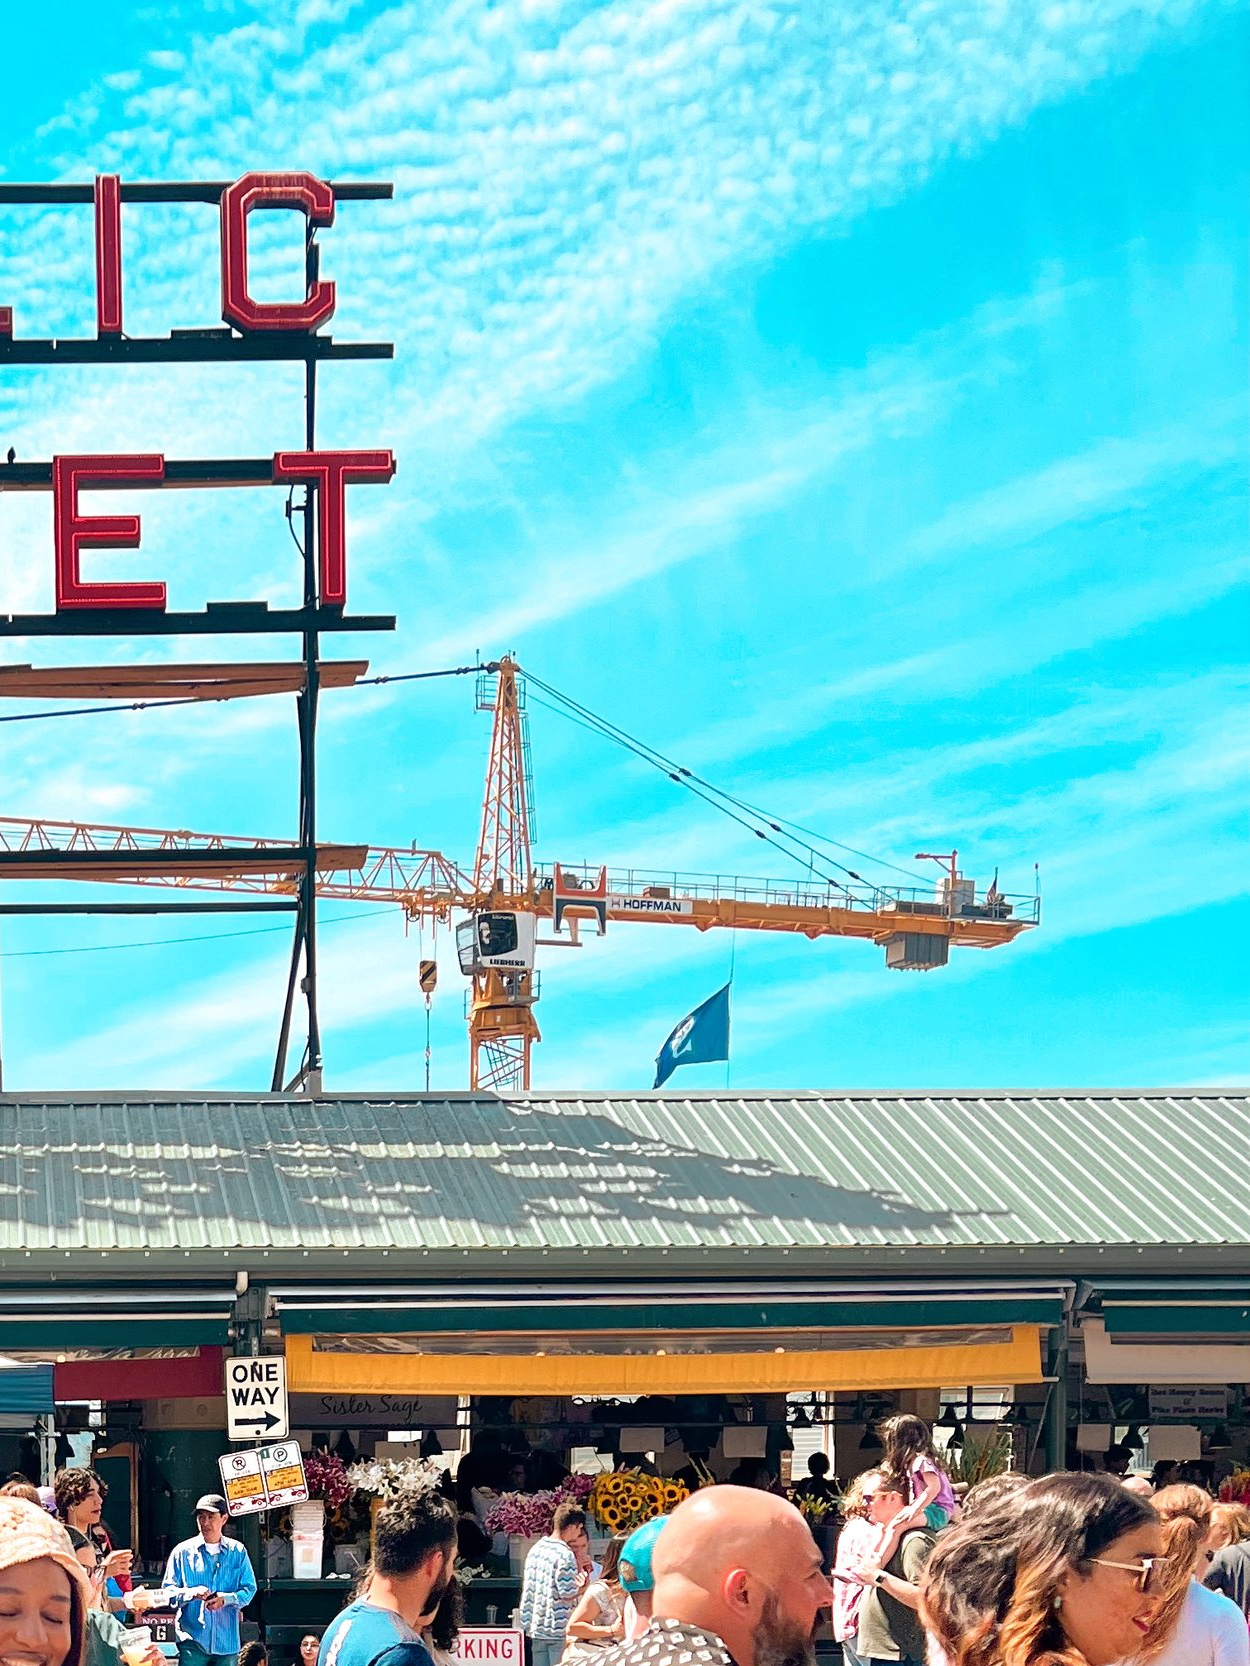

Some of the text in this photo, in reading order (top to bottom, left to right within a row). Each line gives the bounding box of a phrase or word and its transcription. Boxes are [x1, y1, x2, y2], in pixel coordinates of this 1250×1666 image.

[623, 899, 682, 912] HOFFMAN
[232, 1363, 279, 1384] ONE
[231, 1386, 280, 1407] WAY
[319, 1393, 424, 1424] Sister Sage
[455, 1638, 513, 1659] RKING
